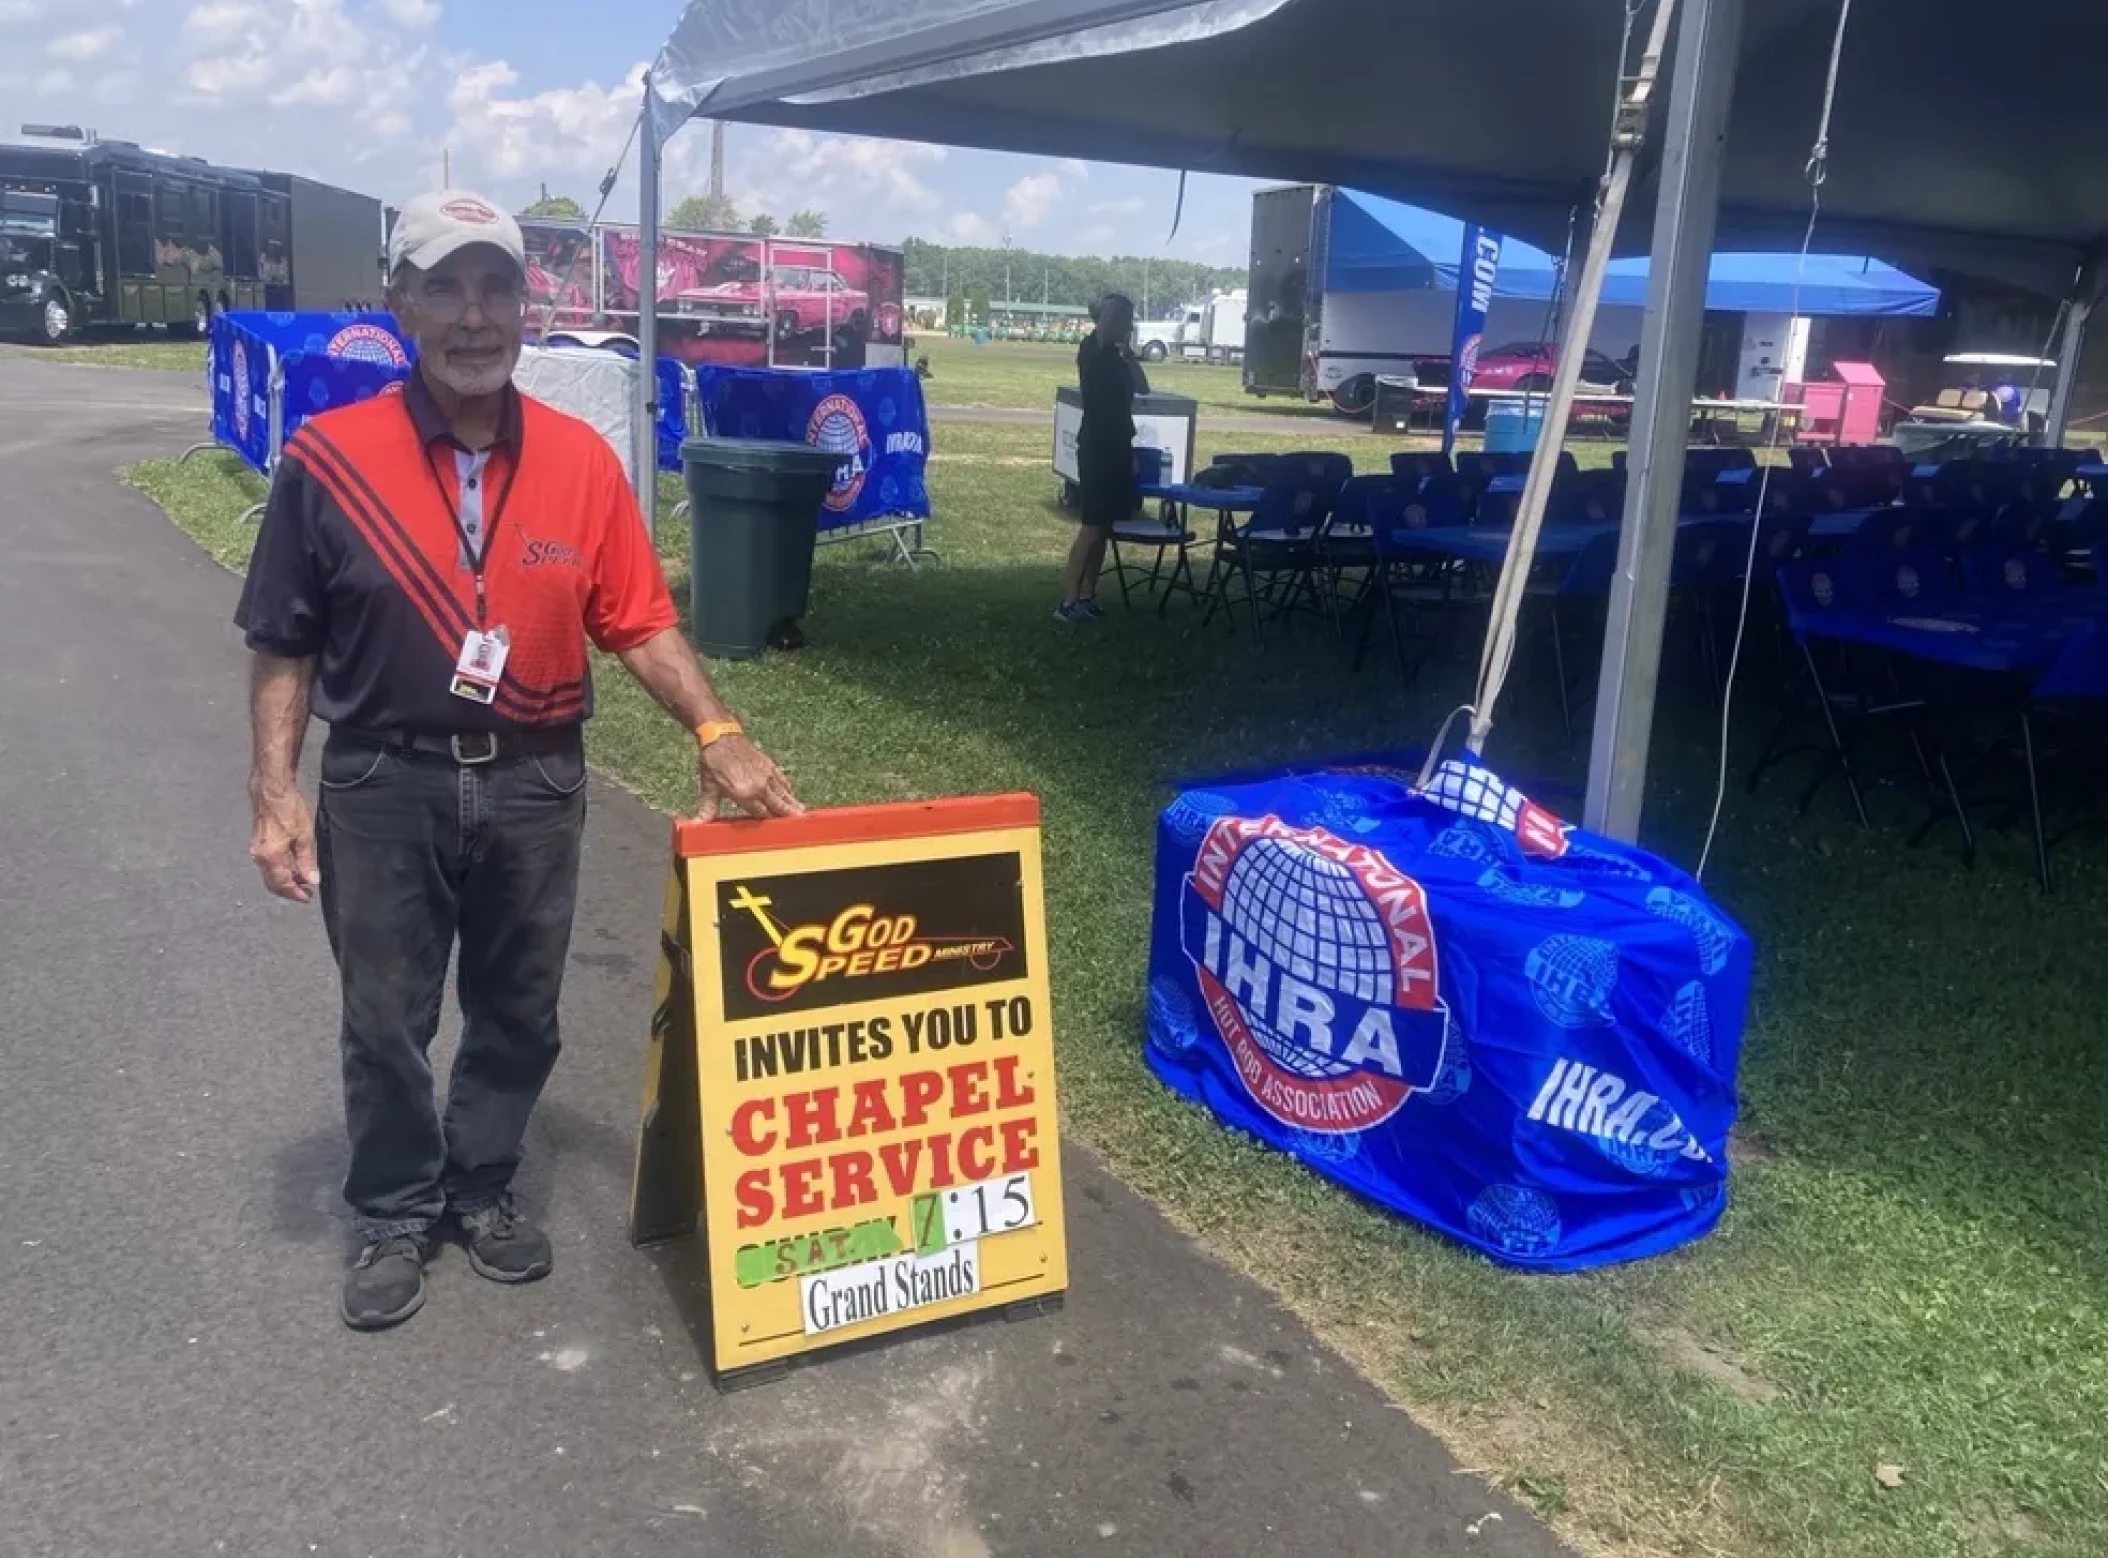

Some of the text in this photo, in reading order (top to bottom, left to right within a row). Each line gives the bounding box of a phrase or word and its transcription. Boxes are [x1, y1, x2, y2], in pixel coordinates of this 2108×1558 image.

[766, 924, 995, 989] SPEED MINISTRY
[825, 903, 918, 953] GOD
[1203, 910, 1402, 1077] IHRA
[733, 995, 1033, 1083] INVITES YOU TO
[1212, 995, 1241, 1041] HOT
[1261, 1079, 1383, 1121] ASSOCIATION
[731, 1055, 1035, 1157] CHAPEL
[734, 1116, 1040, 1230] SERVICE
[914, 1174, 1030, 1249] 7:15
[808, 1247, 974, 1331] Grand Stands
